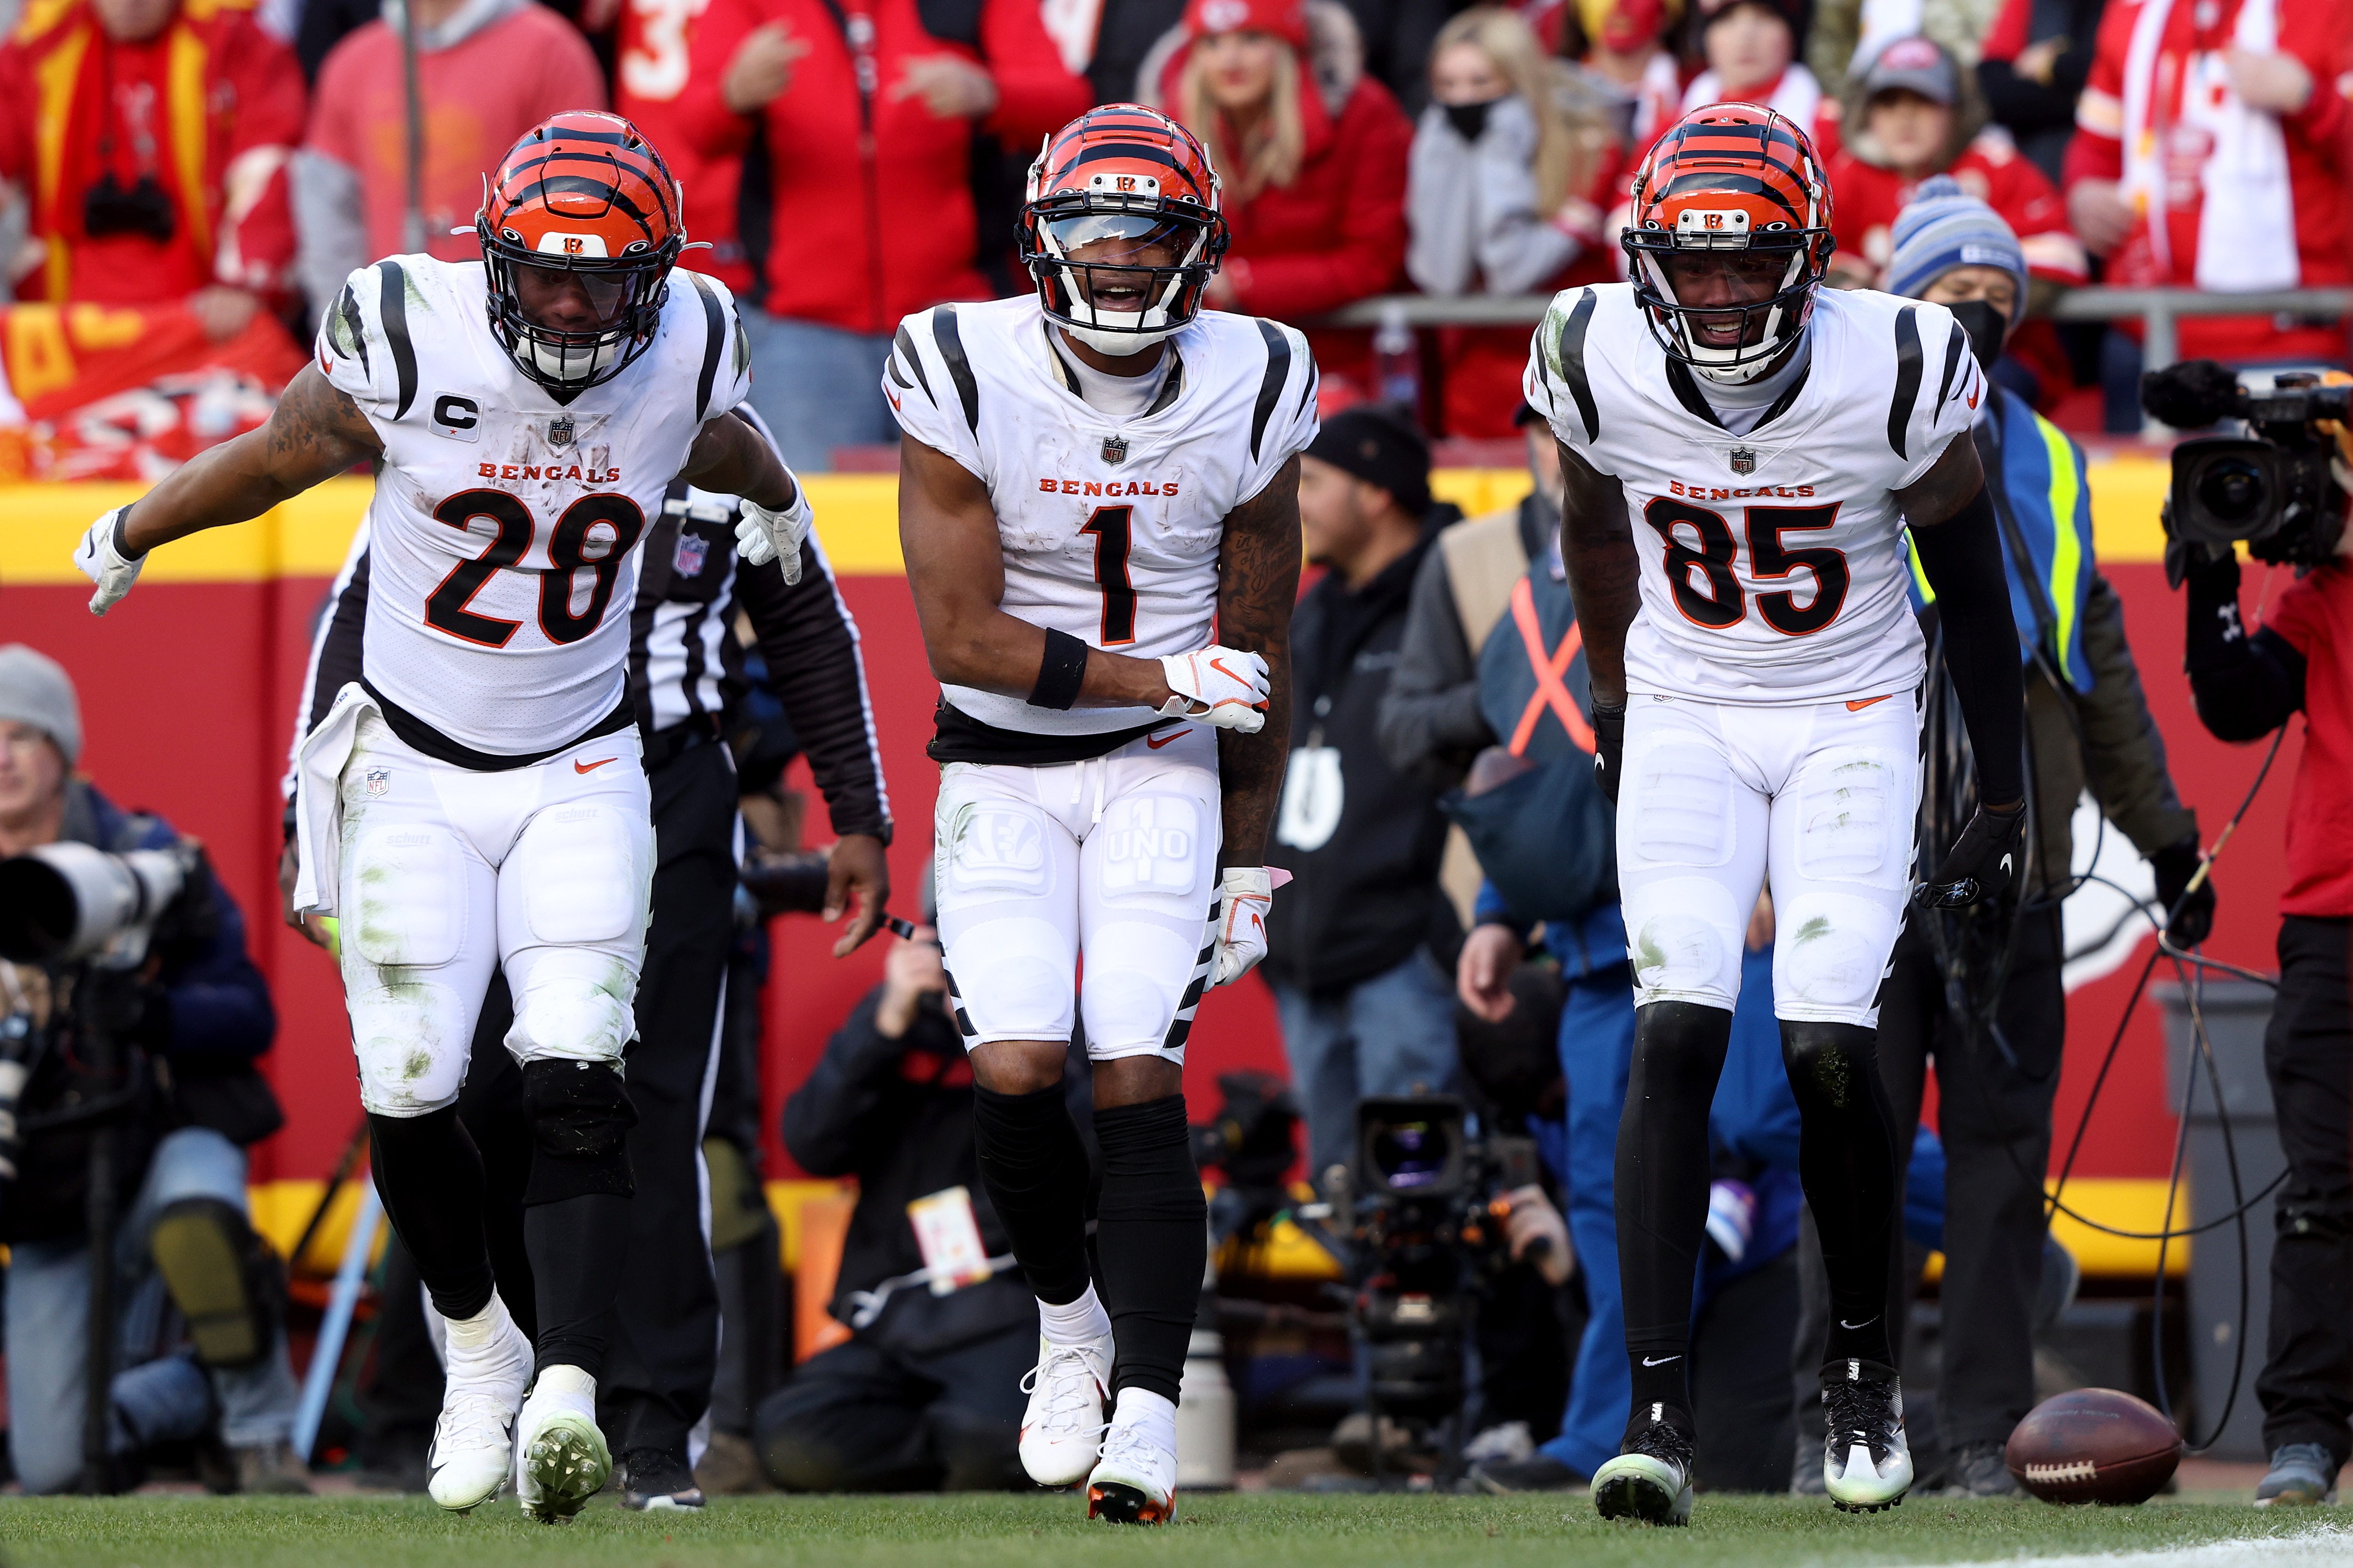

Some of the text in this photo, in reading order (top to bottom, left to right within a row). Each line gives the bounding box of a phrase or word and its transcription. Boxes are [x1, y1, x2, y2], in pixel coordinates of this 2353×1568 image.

[434, 395, 479, 429] C
[552, 431, 570, 443] NFL
[1105, 448, 1122, 461] NFL
[478, 462, 620, 483] BENGALS
[1733, 460, 1752, 472] NFL
[1039, 478, 1179, 497] BENGALS
[1669, 480, 1815, 500] BENGALS
[423, 488, 646, 649] 28
[1078, 505, 1138, 647] 1
[1643, 496, 1850, 636] 85
[368, 780, 385, 792] NFL
[1109, 828, 1188, 863] UNO
[1848, 1361, 1860, 1381] VPR
[1651, 1403, 1663, 1422] VPR
